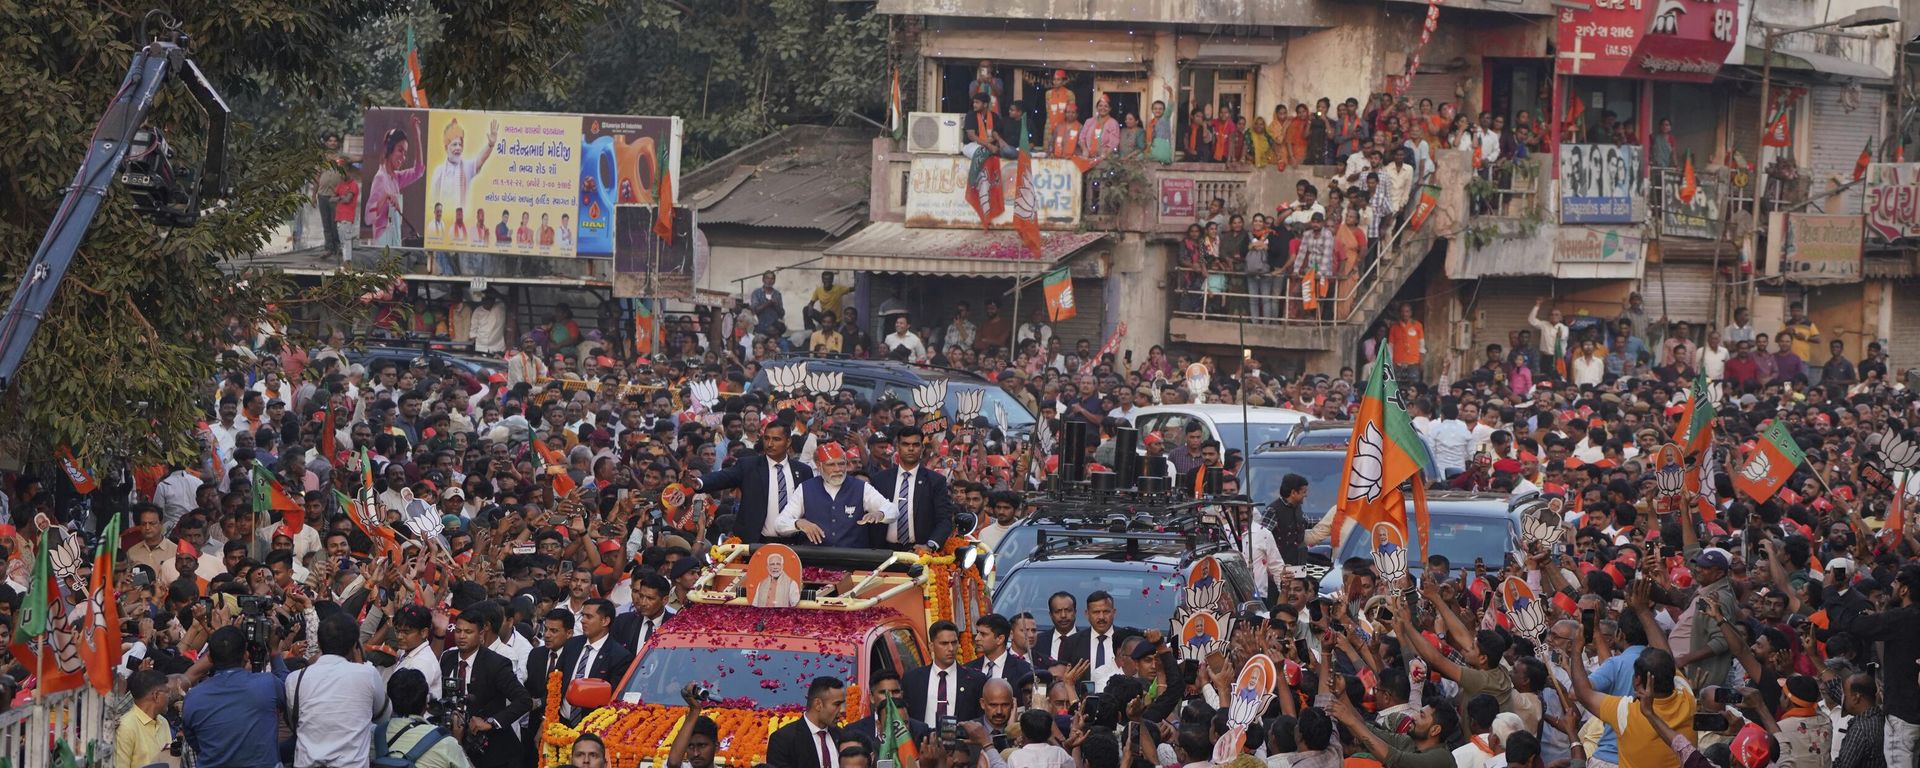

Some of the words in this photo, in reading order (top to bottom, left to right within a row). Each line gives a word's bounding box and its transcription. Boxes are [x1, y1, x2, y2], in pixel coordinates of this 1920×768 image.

[1575, 22, 1608, 37] રાજેશ
[1610, 25, 1634, 38] શાહ
[497, 138, 507, 155] શ્રી
[509, 139, 545, 157] નરેન્દ્રભાઈ
[547, 140, 571, 162] મોદીજી
[508, 160, 516, 173] નો
[519, 164, 533, 174] ભવ્ય
[535, 161, 546, 175] રોડ
